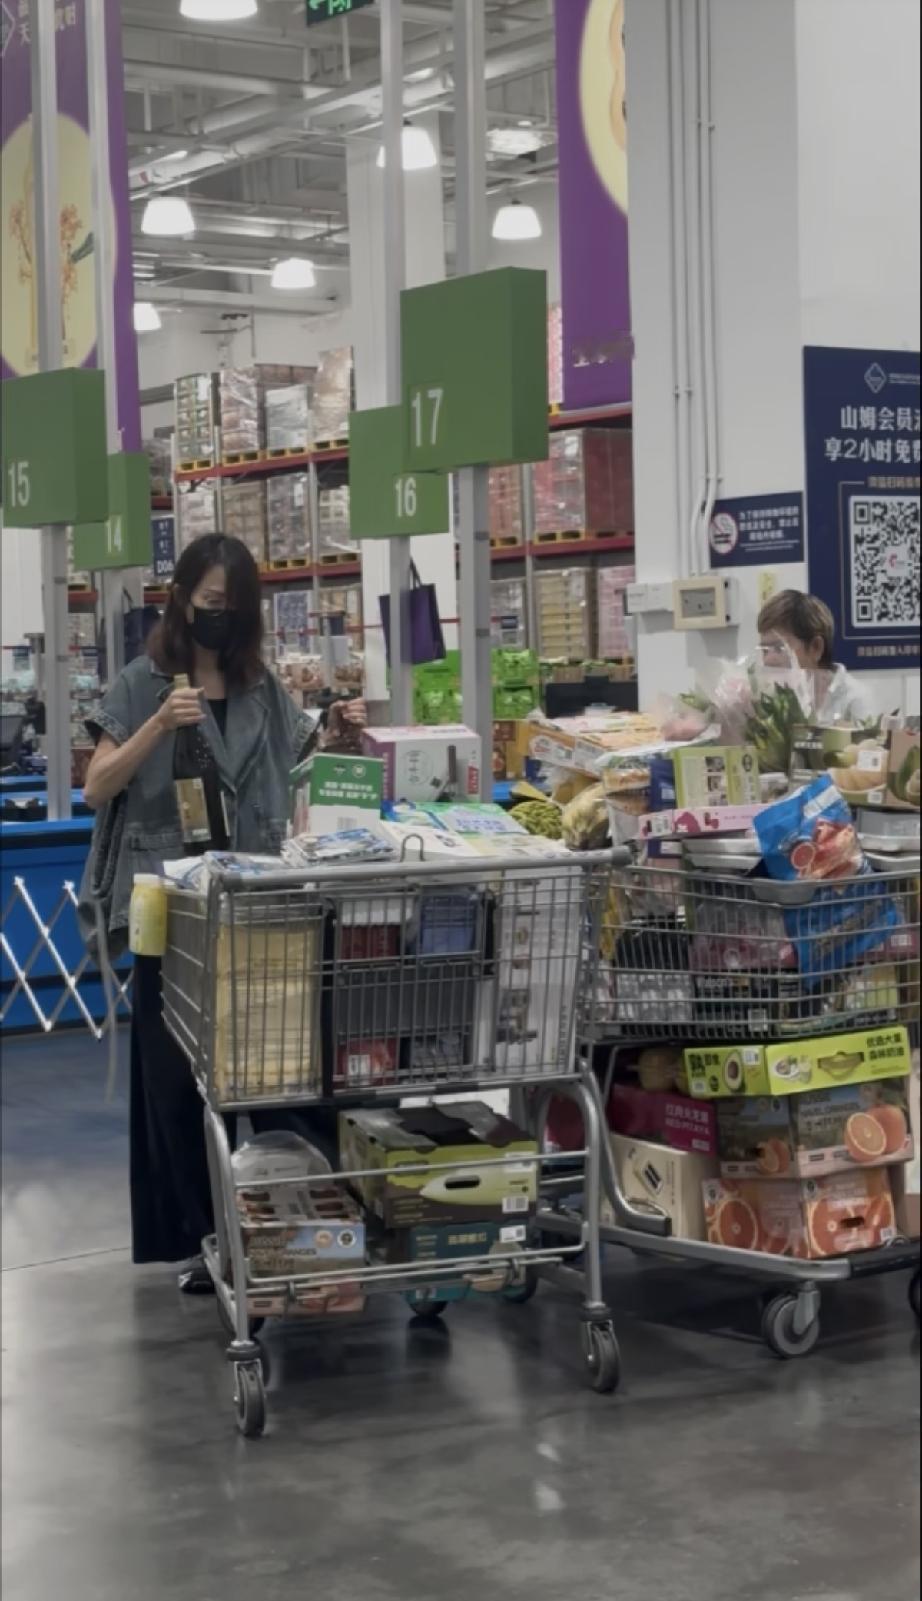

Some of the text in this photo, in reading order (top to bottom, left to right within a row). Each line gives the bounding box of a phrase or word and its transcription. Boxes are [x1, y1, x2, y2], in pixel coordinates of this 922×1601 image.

[411, 388, 443, 448] 17
[7, 462, 31, 507] 15
[394, 478, 417, 517] 16
[106, 515, 123, 553] 14
